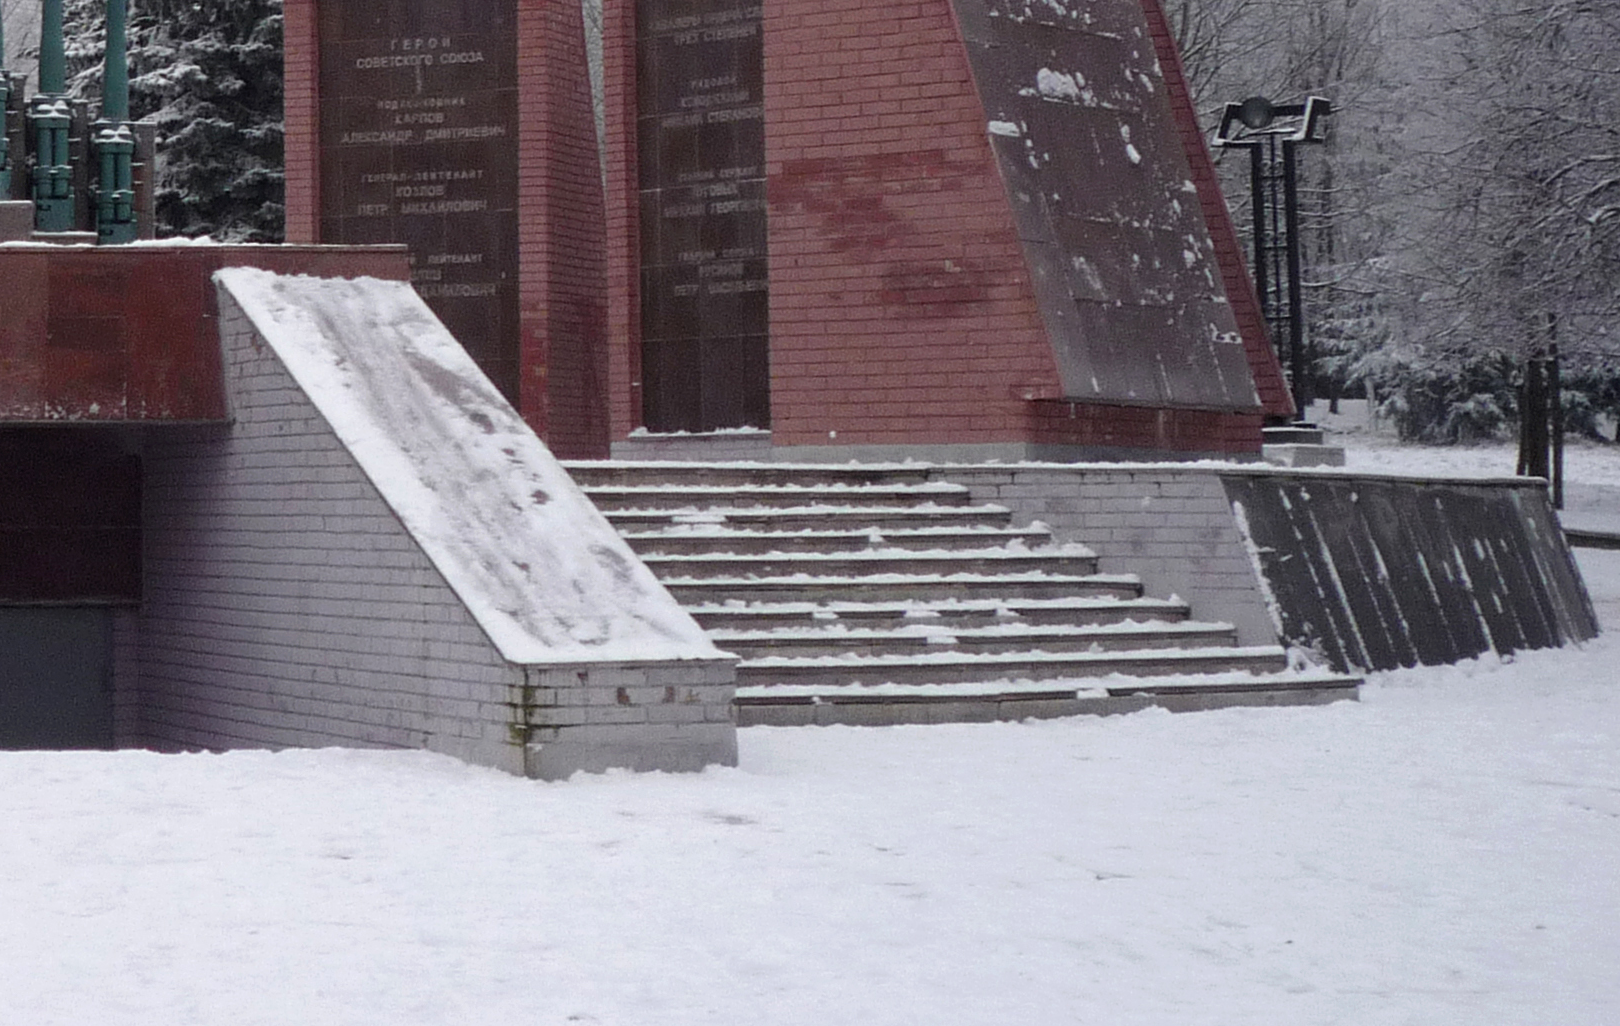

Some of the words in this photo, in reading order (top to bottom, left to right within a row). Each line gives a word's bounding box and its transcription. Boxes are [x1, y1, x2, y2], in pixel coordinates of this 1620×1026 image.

[390, 37, 452, 51] ГЕРОИ
[356, 54, 433, 69] СОВЕТСКОГО
[440, 51, 484, 65] СОЮЗА
[395, 112, 445, 125] КАРПОВ
[341, 129, 413, 144] АЛЕКСАНДР
[425, 125, 506, 141] ДМИТРИЕВИЧ
[358, 203, 389, 216] ПЕТР
